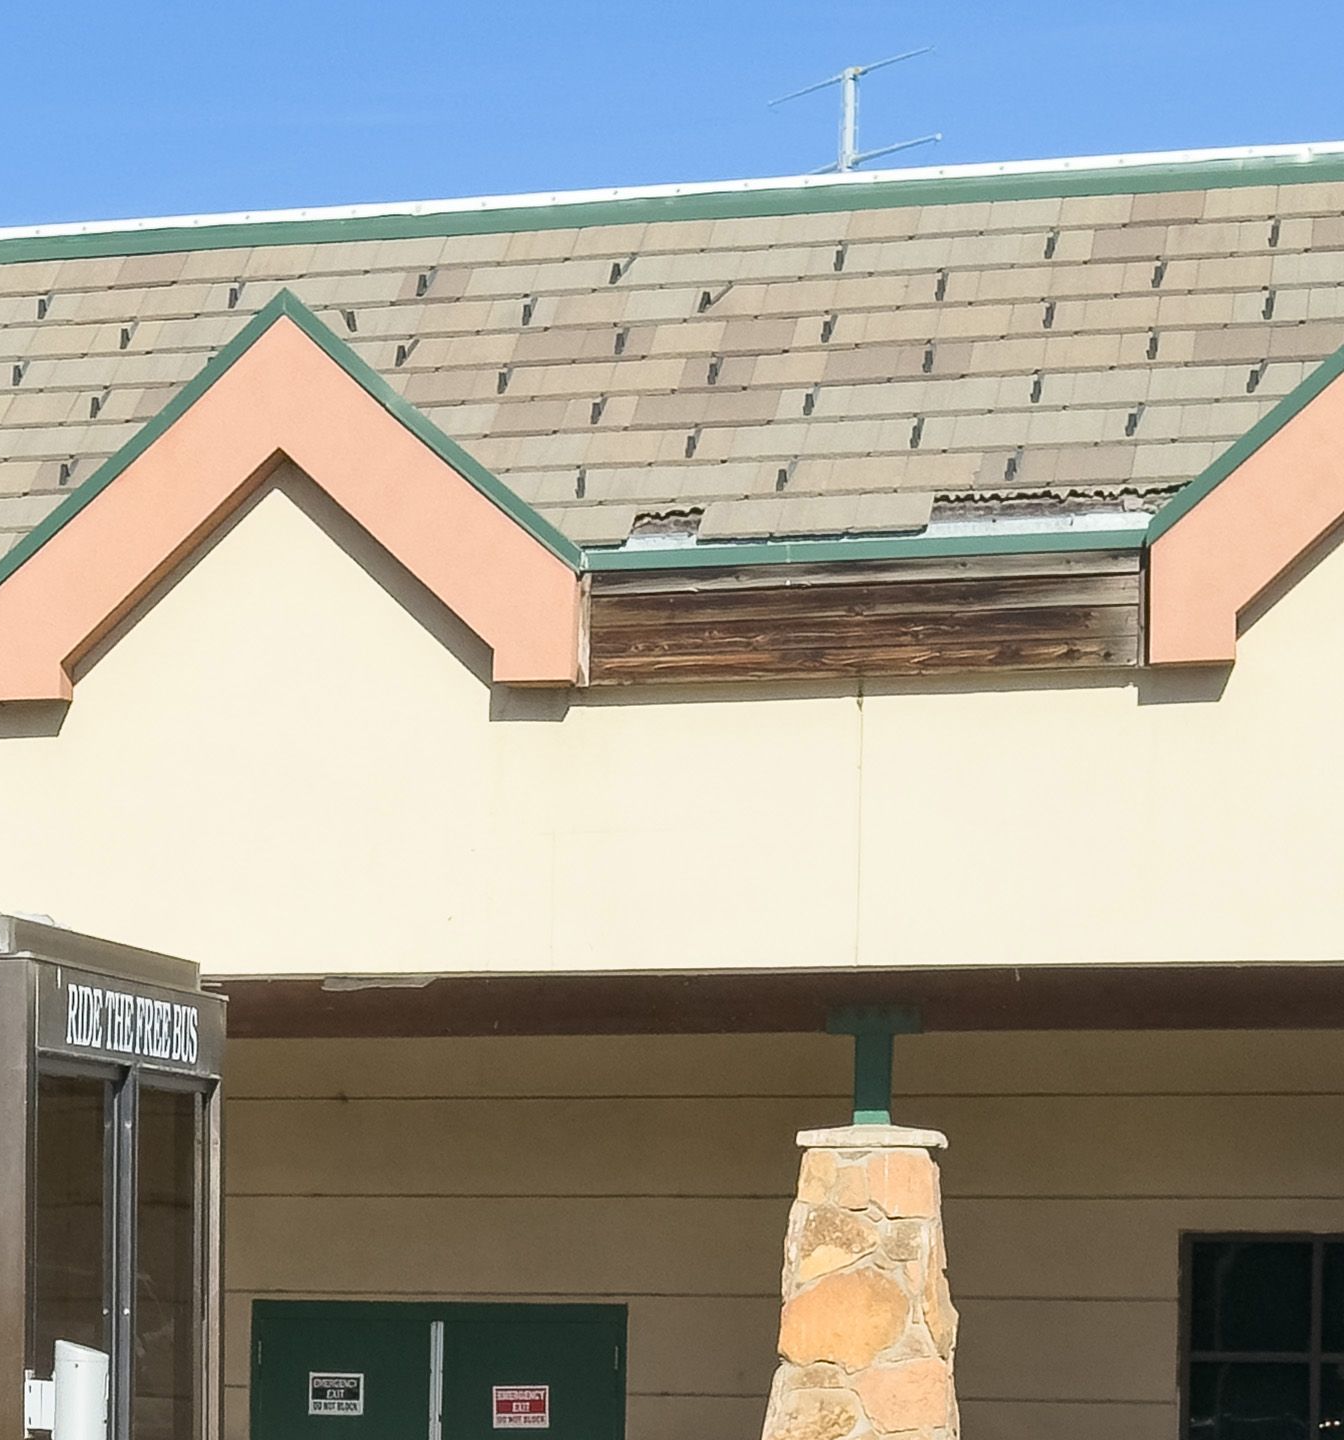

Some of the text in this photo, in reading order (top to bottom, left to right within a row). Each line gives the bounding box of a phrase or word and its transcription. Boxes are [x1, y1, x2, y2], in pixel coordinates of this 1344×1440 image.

[66, 983, 198, 1065] RIDE THE FREE BUS
